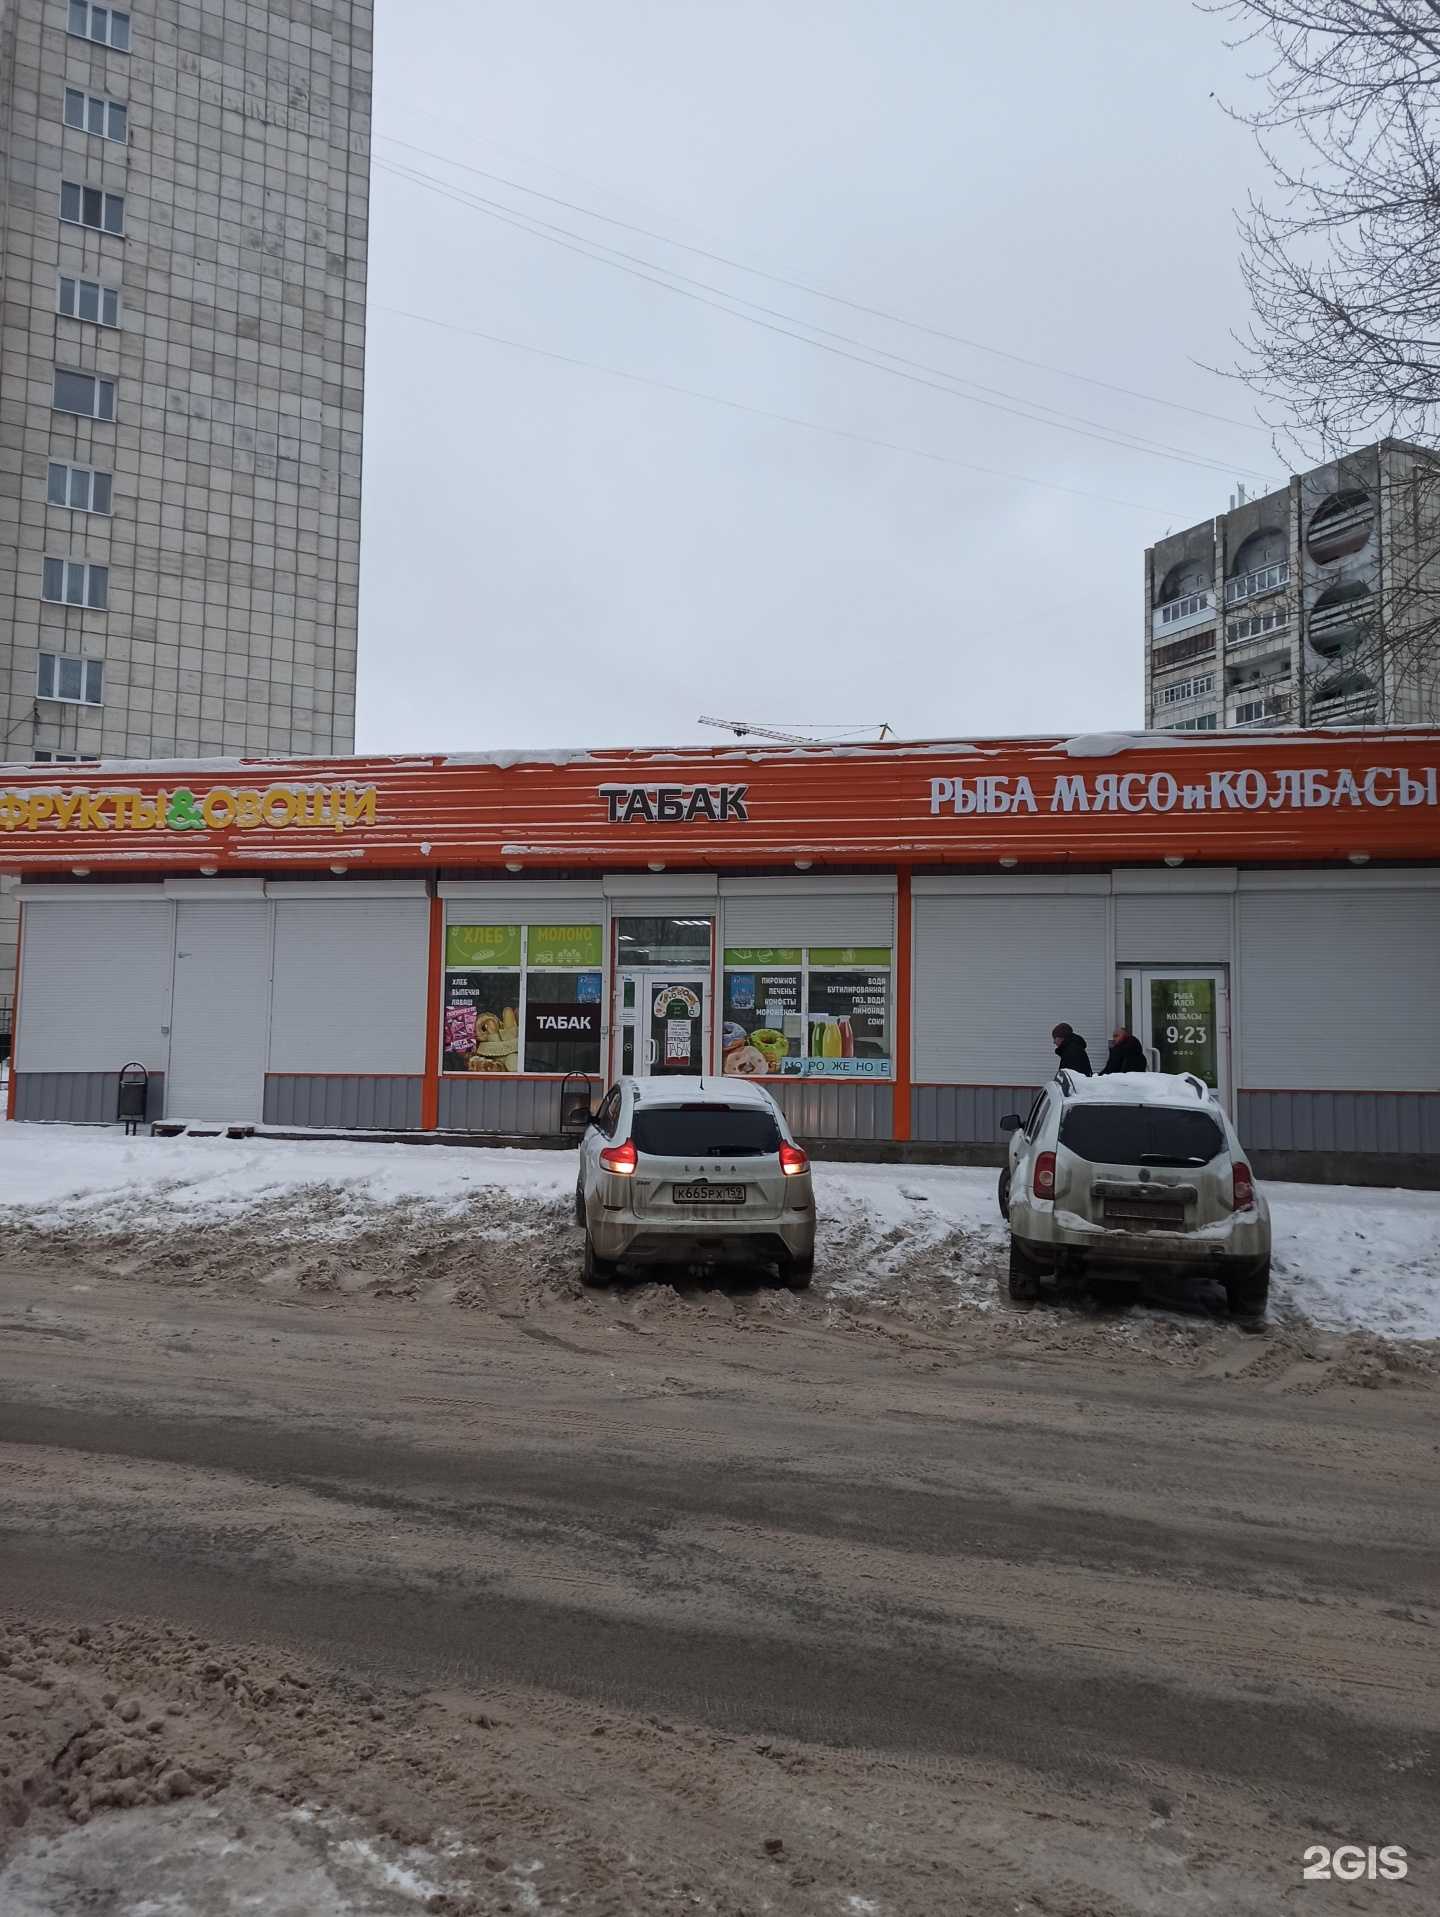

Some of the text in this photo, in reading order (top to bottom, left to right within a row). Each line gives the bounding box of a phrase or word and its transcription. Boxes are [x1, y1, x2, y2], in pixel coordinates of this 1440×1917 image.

[930, 776, 1038, 814] РЫБА
[599, 786, 749, 822] ТАБАК
[463, 927, 504, 944] ХЛЕБ
[538, 927, 592, 943] МОЛОКО
[761, 977, 797, 985] ПИРОЖНОЕ
[867, 977, 886, 985] ВОДА
[768, 987, 797, 995] ПЕЧЕНЬЕ
[764, 998, 797, 1006] КОНФЕТЫ
[867, 996, 886, 1004] ВОДА
[536, 1016, 591, 1029] ТАБАК
[1166, 1026, 1207, 1044] 9-23
